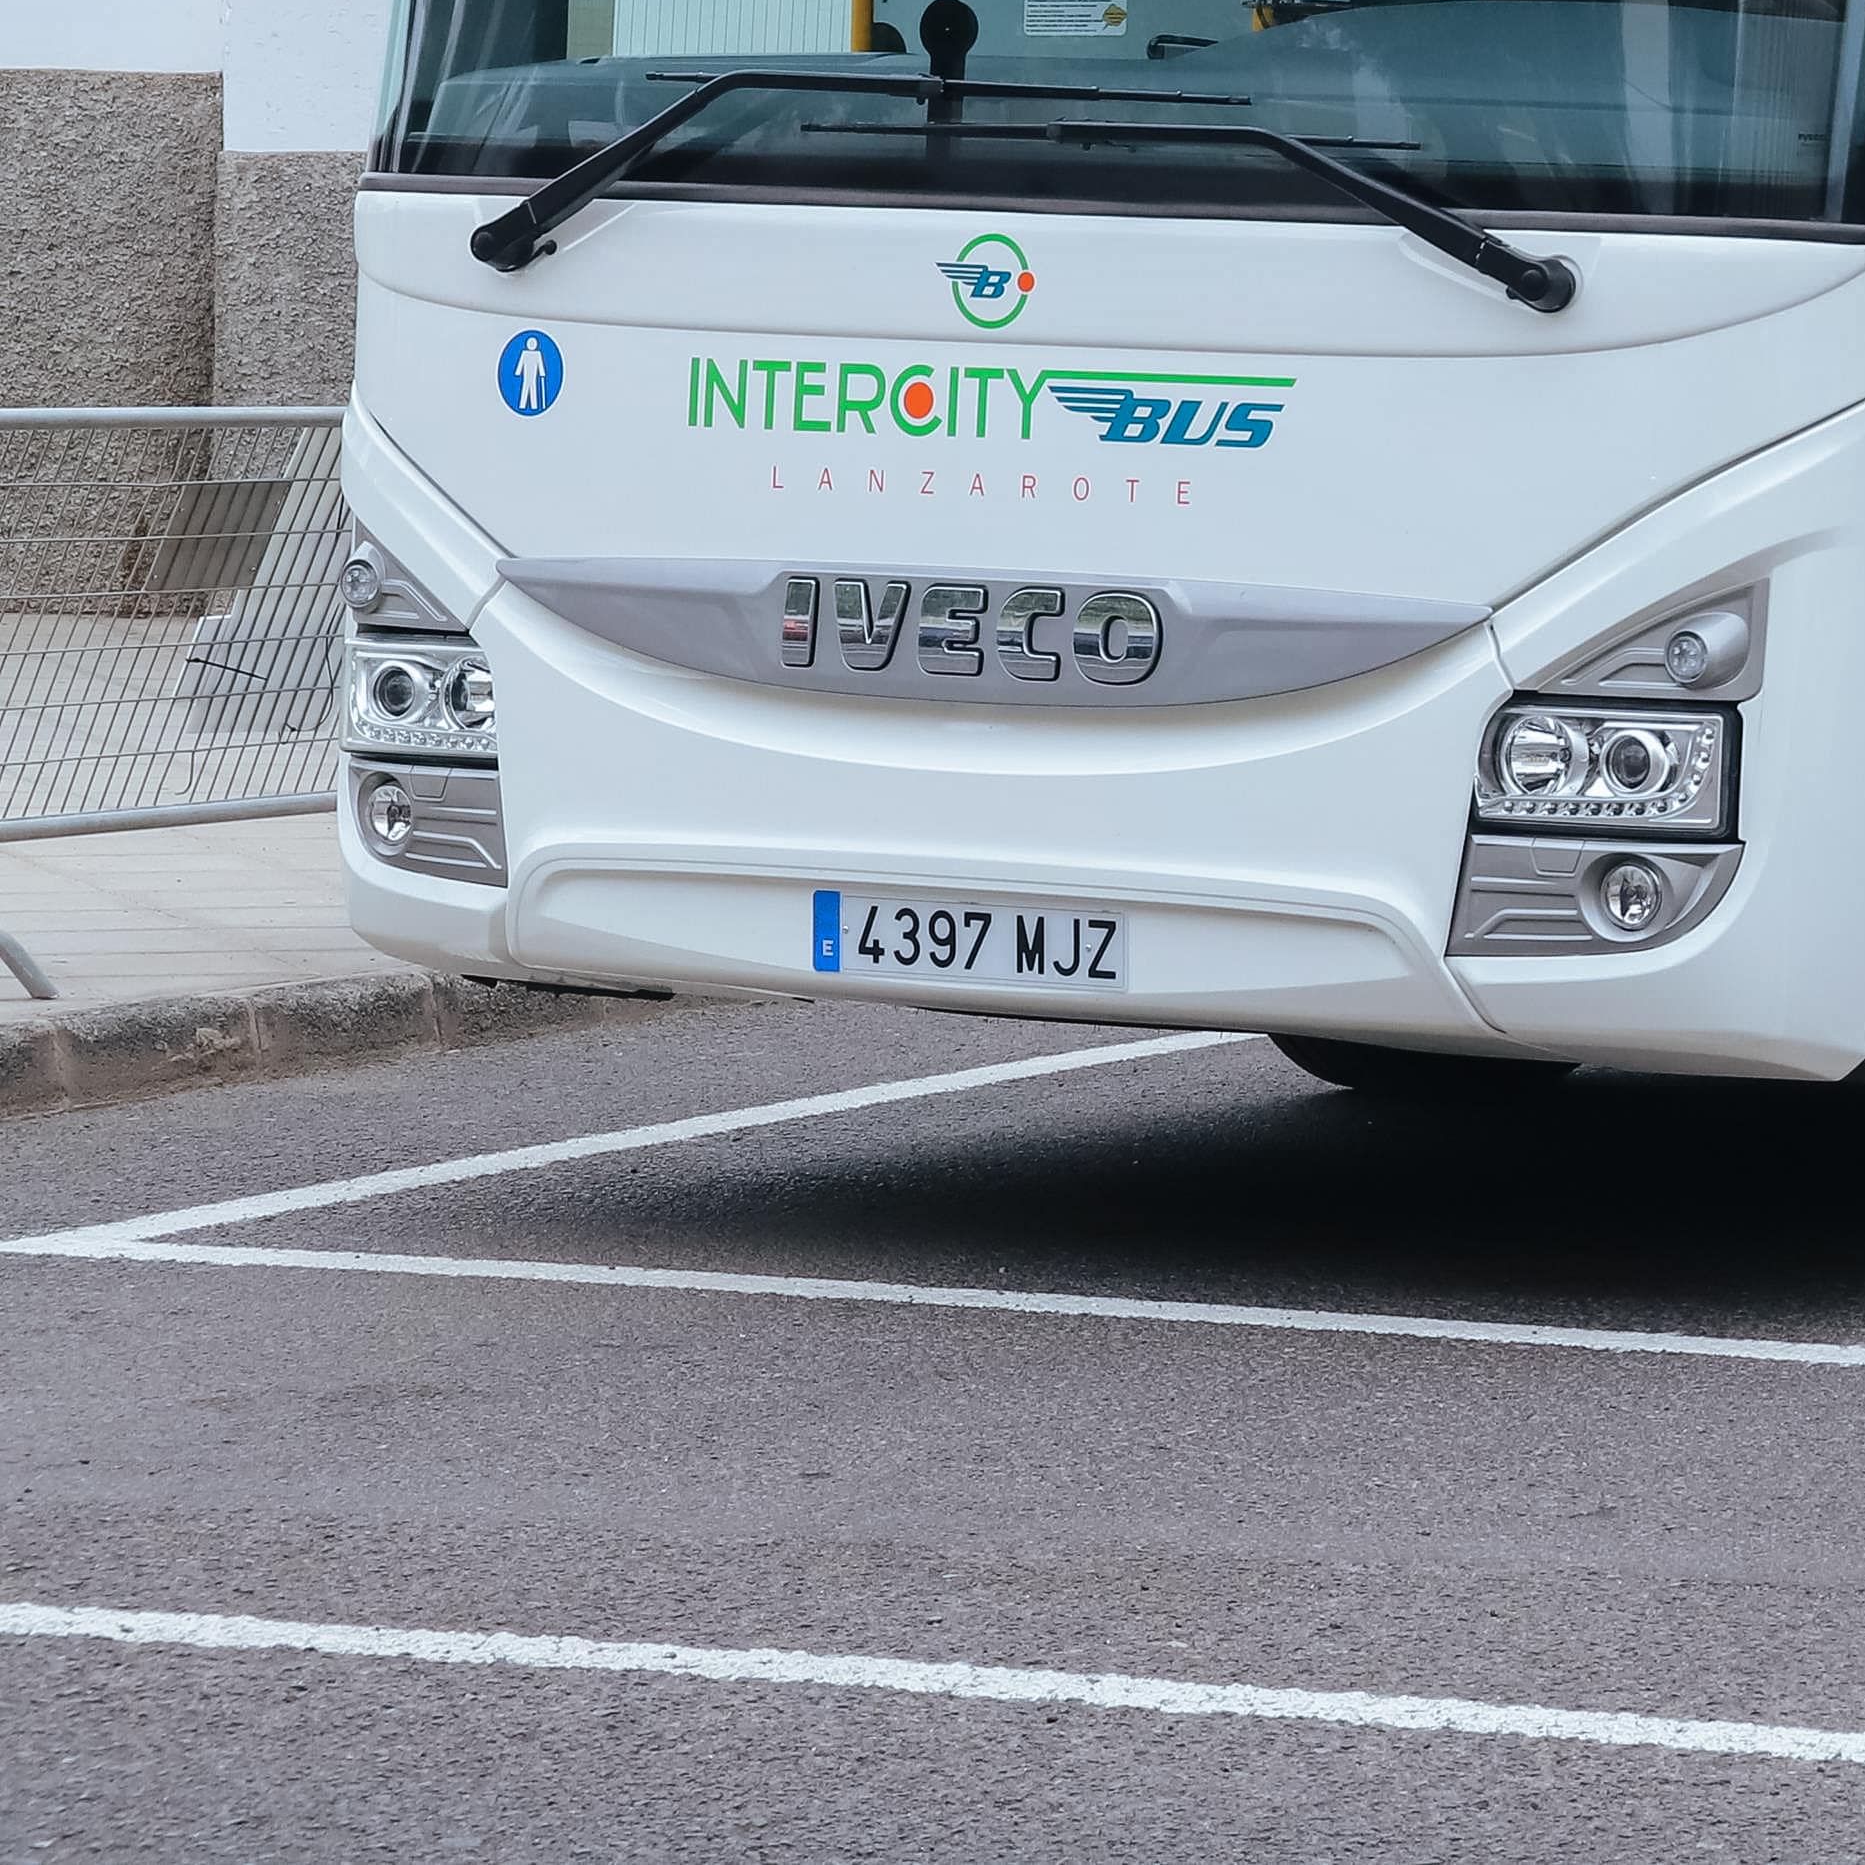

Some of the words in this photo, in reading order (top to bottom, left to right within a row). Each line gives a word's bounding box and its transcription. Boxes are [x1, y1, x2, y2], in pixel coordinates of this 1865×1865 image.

[687, 356, 1047, 440] INTERCITY
[1096, 388, 1285, 449] BUS
[771, 465, 1193, 505] LANZAROTE
[778, 577, 1164, 685] IVECO
[821, 939, 834, 957] E
[857, 905, 992, 971] 4397
[1015, 914, 1117, 980] MJZ
